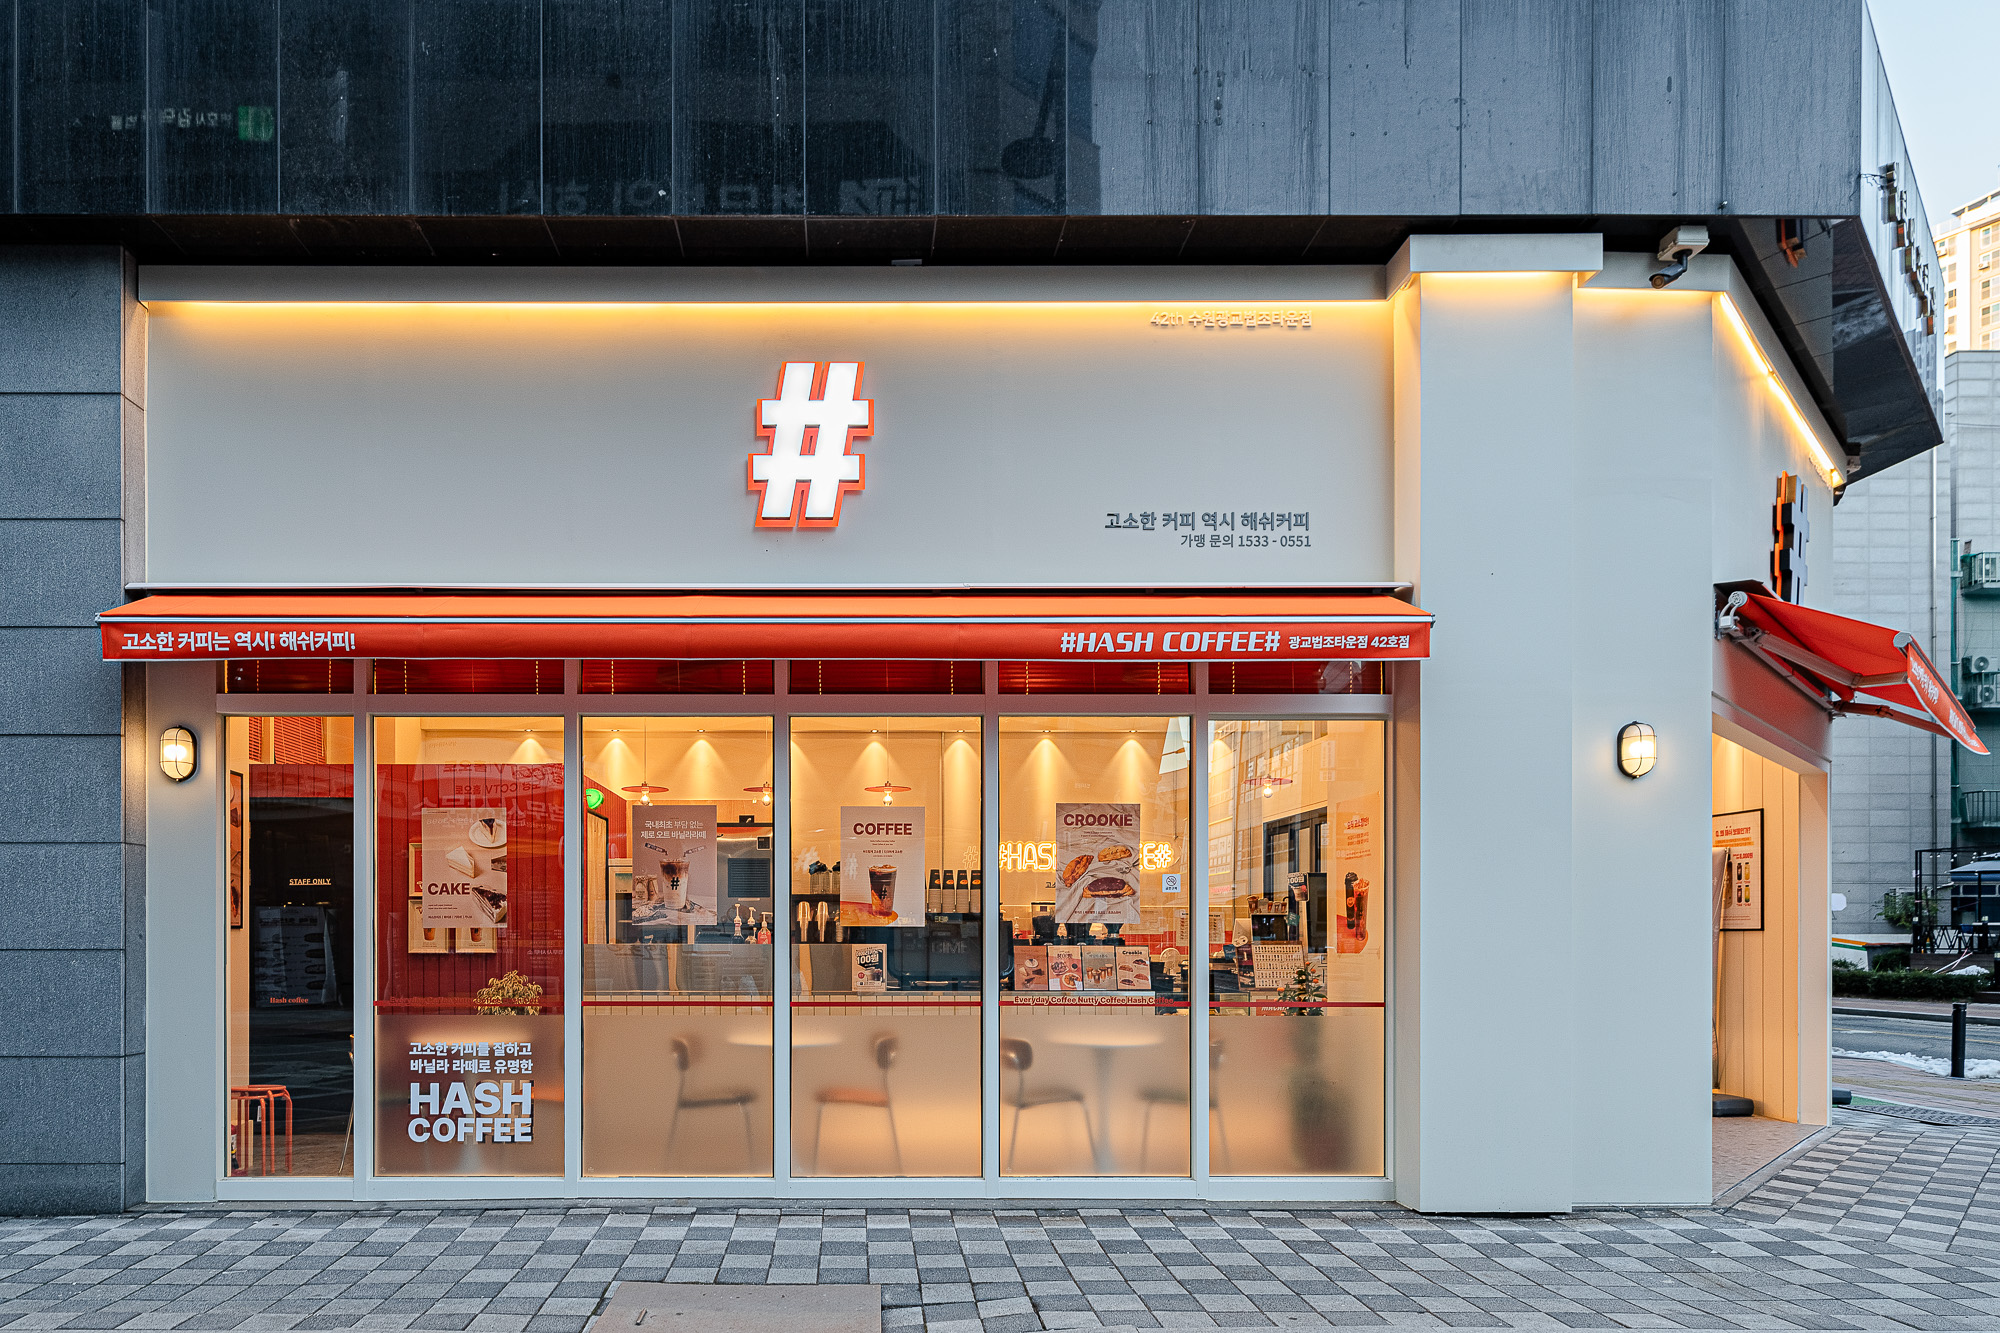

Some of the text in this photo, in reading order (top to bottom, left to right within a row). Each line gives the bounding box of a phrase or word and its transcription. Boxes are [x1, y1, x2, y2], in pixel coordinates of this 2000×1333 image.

[1150, 310, 1313, 328] 42th 수원광교법조타운점
[1104, 511, 1310, 531] 고소한 커피 역시 해쉬커피
[1180, 533, 1206, 548] 가맹
[1209, 533, 1234, 548] 문의
[1280, 535, 1312, 548] 0551
[121, 631, 356, 652] 고소한 커피는 역시! 해쉬커피!
[1060, 631, 1410, 653] #HASH COFFEE# 광교법조타운점 42호점
[644, 820, 673, 829] 국내최초
[1063, 813, 1133, 827] CROOKIE
[641, 830, 655, 839] 제로
[656, 830, 671, 839] 오트
[853, 822, 913, 836] COFFEE
[427, 882, 471, 896] CAKE
[270, 996, 309, 1004] Hash coffee
[1014, 996, 1174, 1005] Everyday Coffee Nutty Coffee Hash Coffee
[408, 1041, 532, 1056] 고소한 커피를 잘하고
[410, 1059, 533, 1074] 바닐라 라떼로 유명한
[409, 1081, 532, 1115] HASH
[407, 1117, 532, 1142] COFFEE
